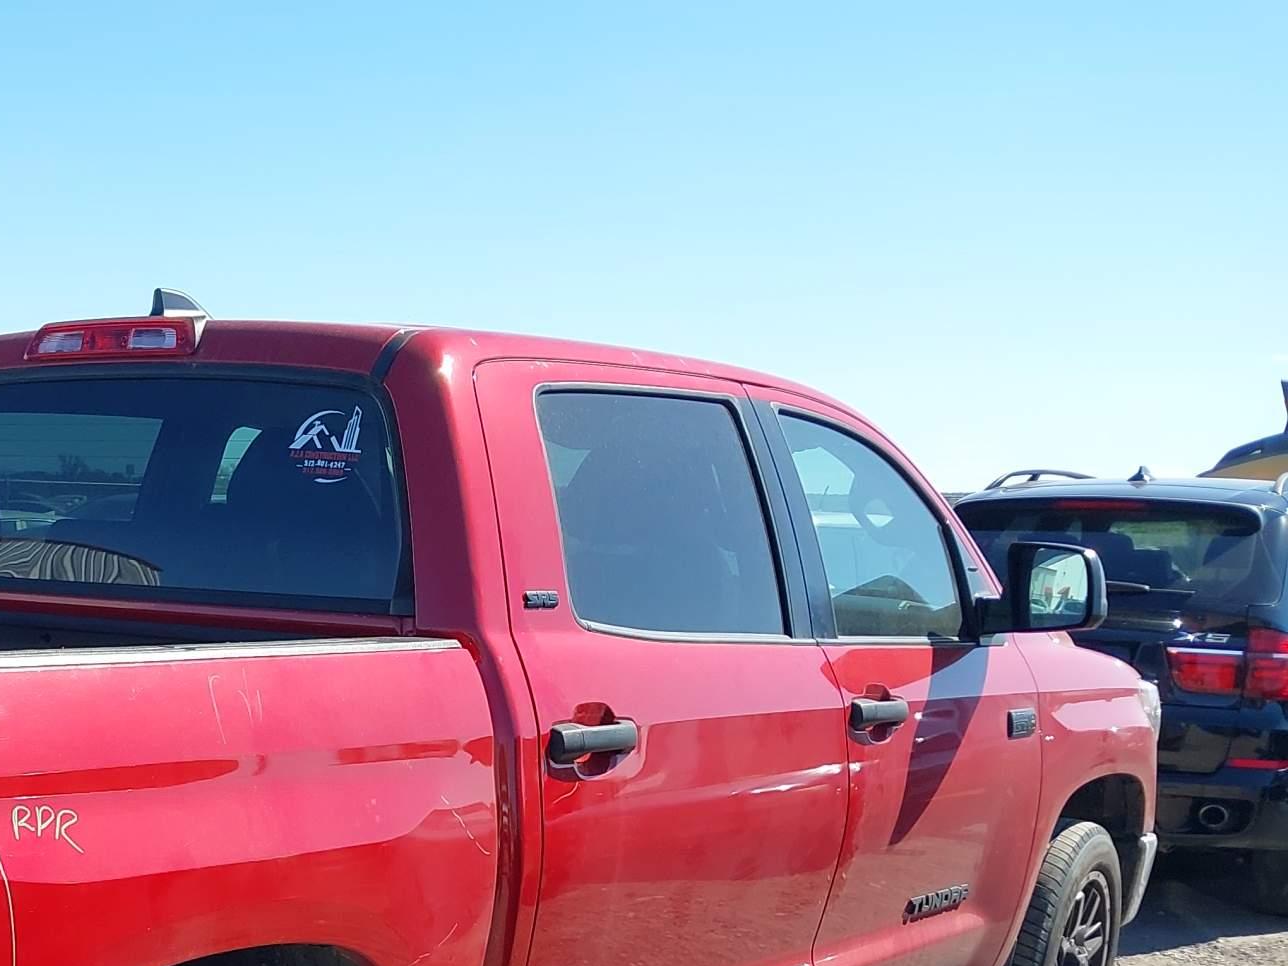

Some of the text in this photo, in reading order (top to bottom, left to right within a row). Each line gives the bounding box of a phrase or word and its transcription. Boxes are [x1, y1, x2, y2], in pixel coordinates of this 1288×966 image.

[1173, 631, 1231, 643] X5
[12, 805, 84, 853] RPR
[906, 884, 969, 920] TUNDRA
